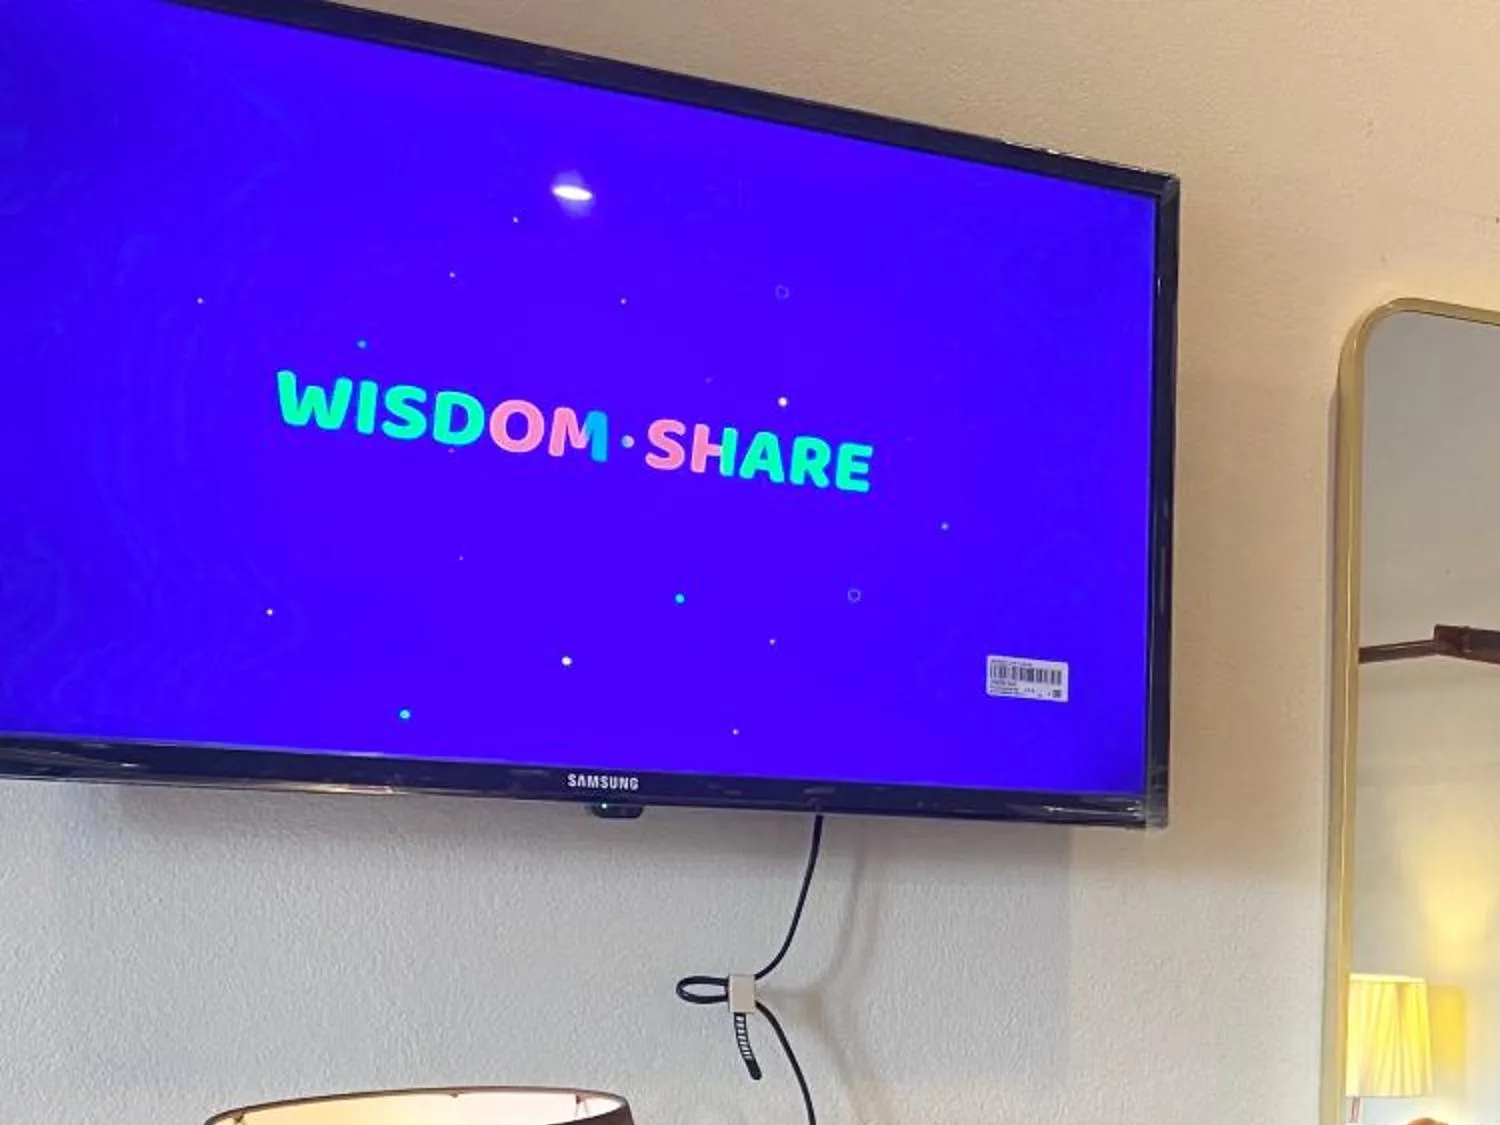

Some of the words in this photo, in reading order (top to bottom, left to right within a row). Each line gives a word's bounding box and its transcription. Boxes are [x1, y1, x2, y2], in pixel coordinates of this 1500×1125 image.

[276, 369, 608, 462] WISDOM
[645, 419, 874, 493] SHARE
[567, 773, 639, 791] SAMSUNG
